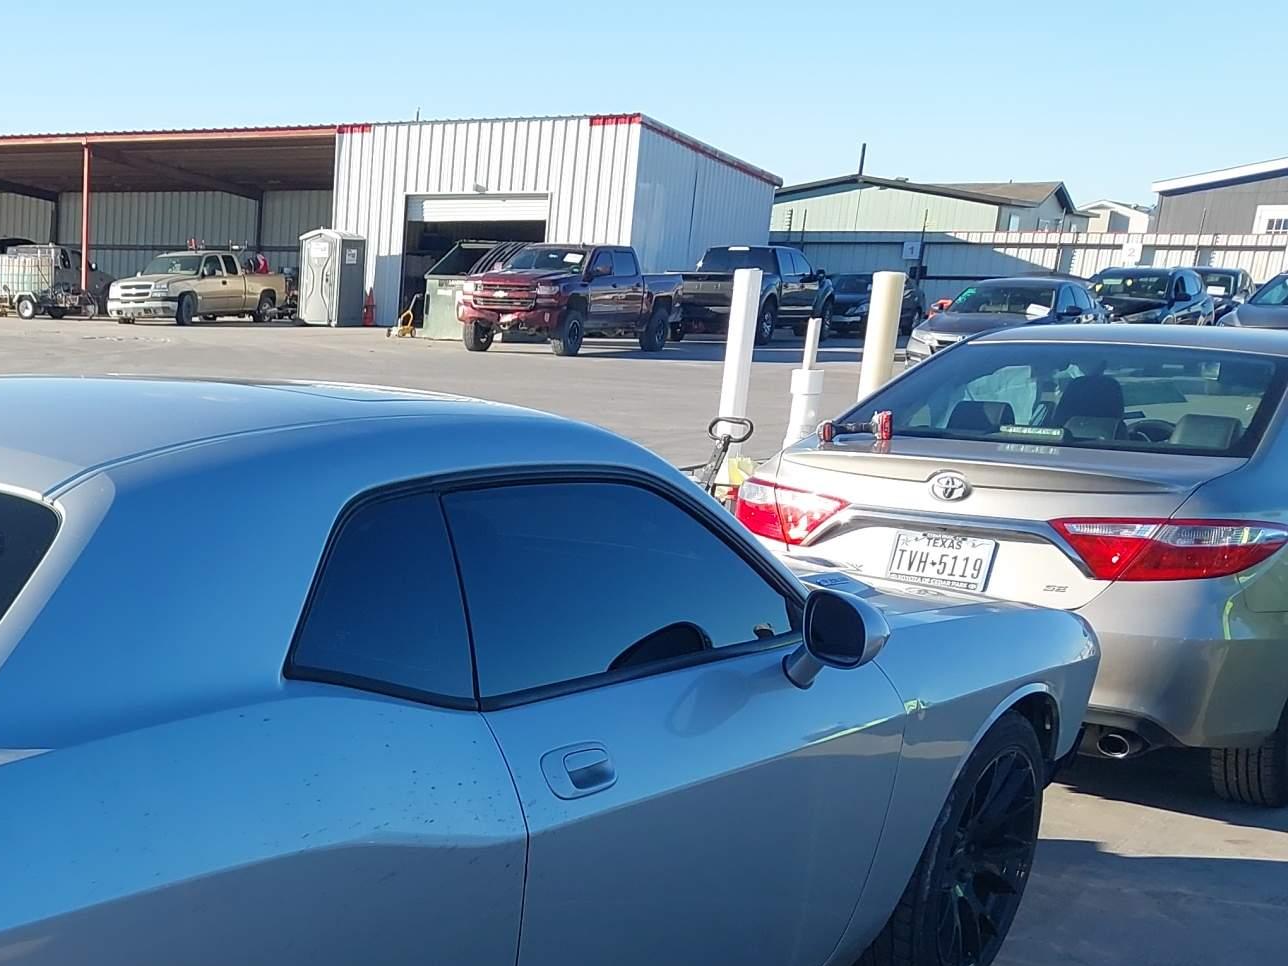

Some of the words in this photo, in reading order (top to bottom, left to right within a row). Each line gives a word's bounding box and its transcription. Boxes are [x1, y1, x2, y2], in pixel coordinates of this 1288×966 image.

[1127, 247, 1136, 257] 2
[926, 537, 963, 550] TEXAS
[1043, 584, 1069, 593] SE
